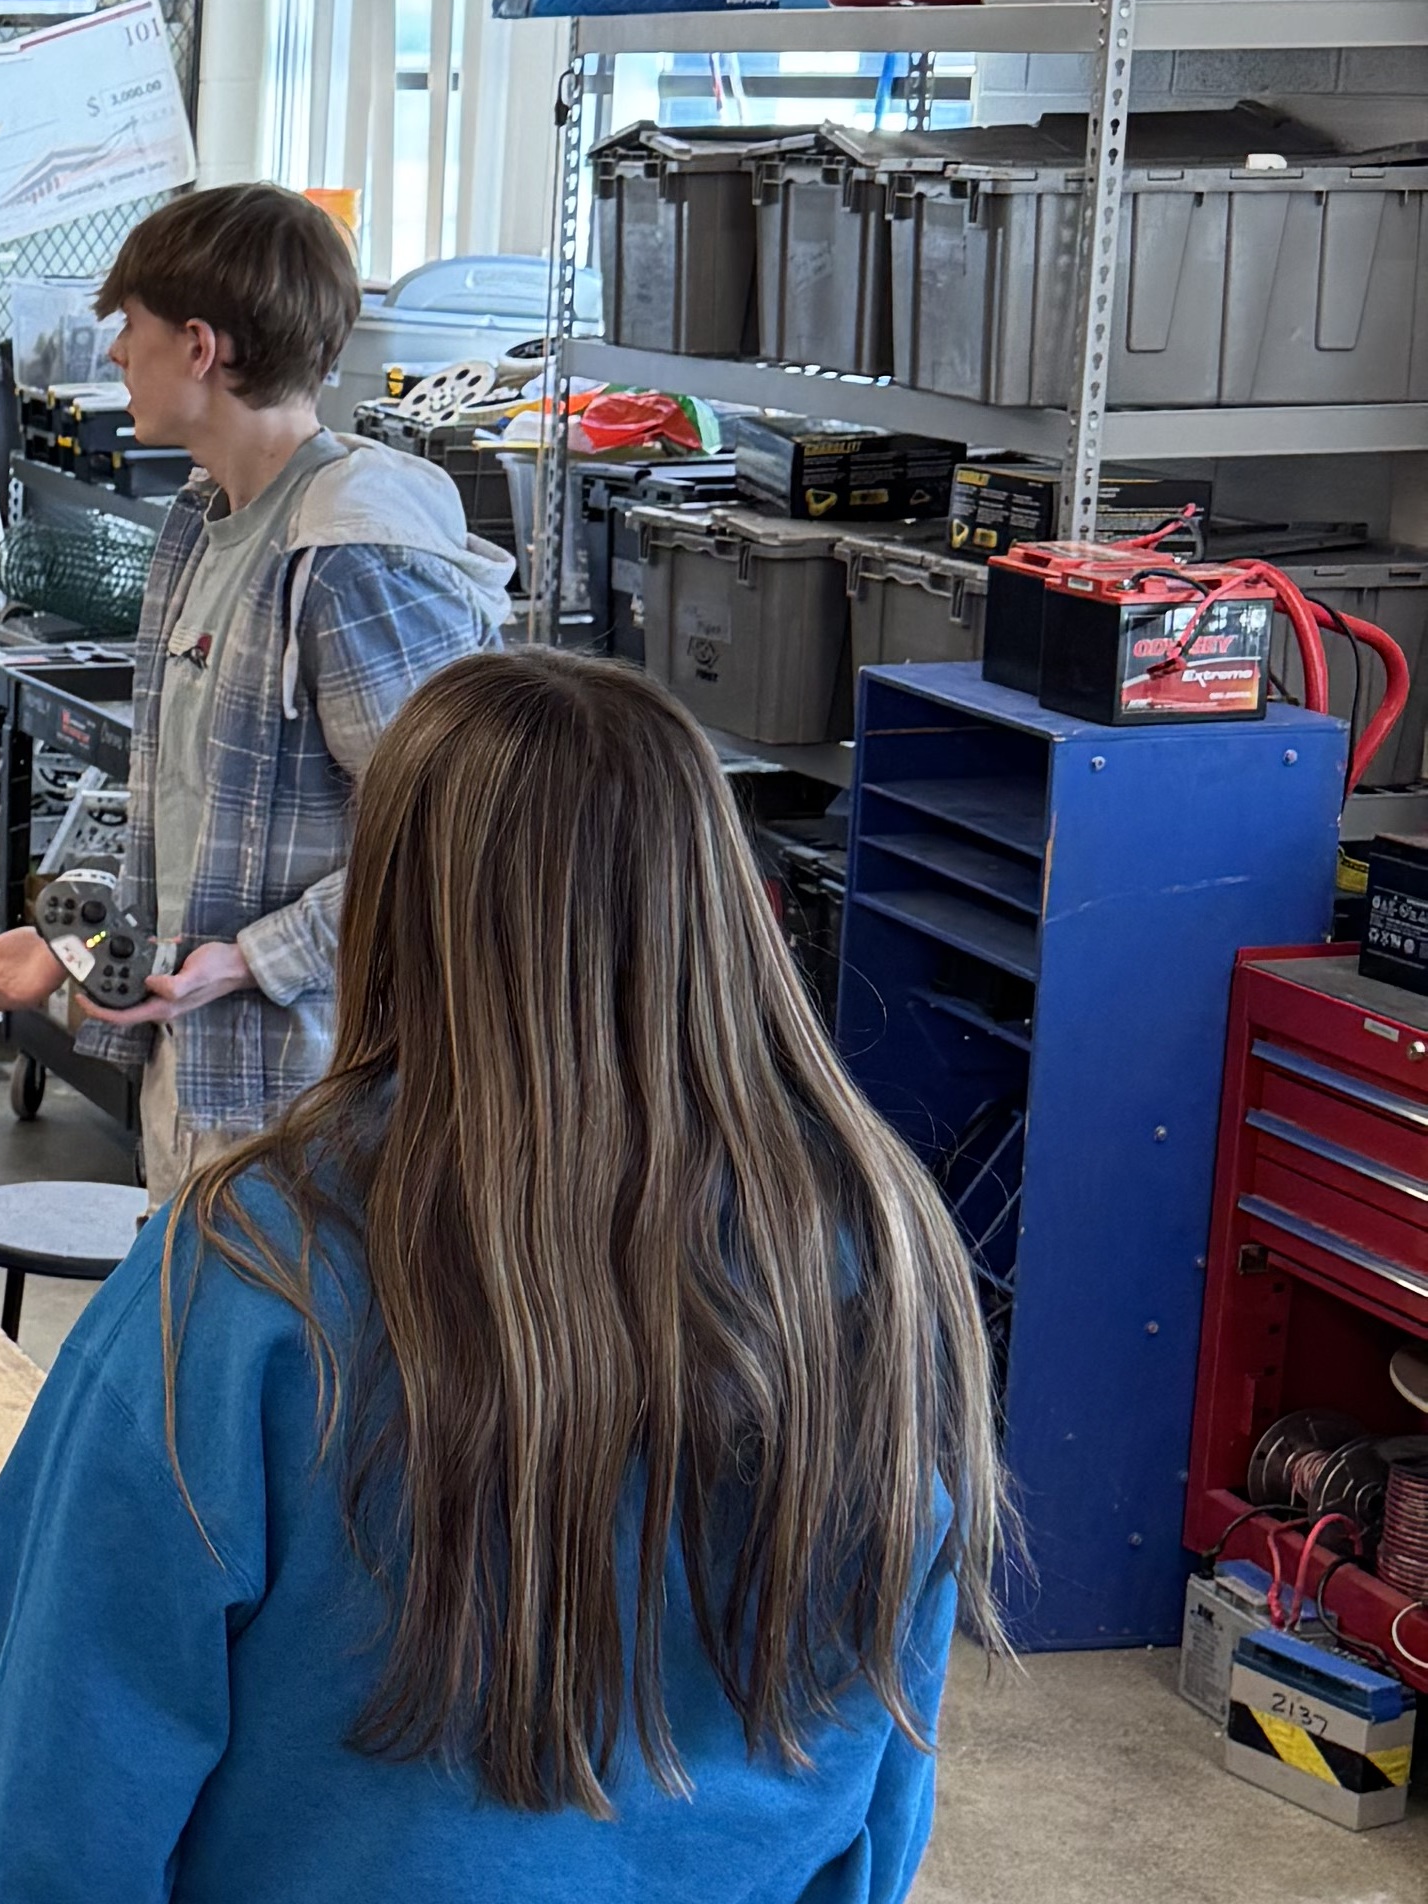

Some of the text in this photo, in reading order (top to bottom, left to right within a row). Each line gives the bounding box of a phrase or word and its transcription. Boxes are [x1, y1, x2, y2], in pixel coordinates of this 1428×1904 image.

[125, 17, 162, 47] 101
[1182, 669, 1254, 688] Extreme
[1271, 1692, 1328, 1735] 2137
